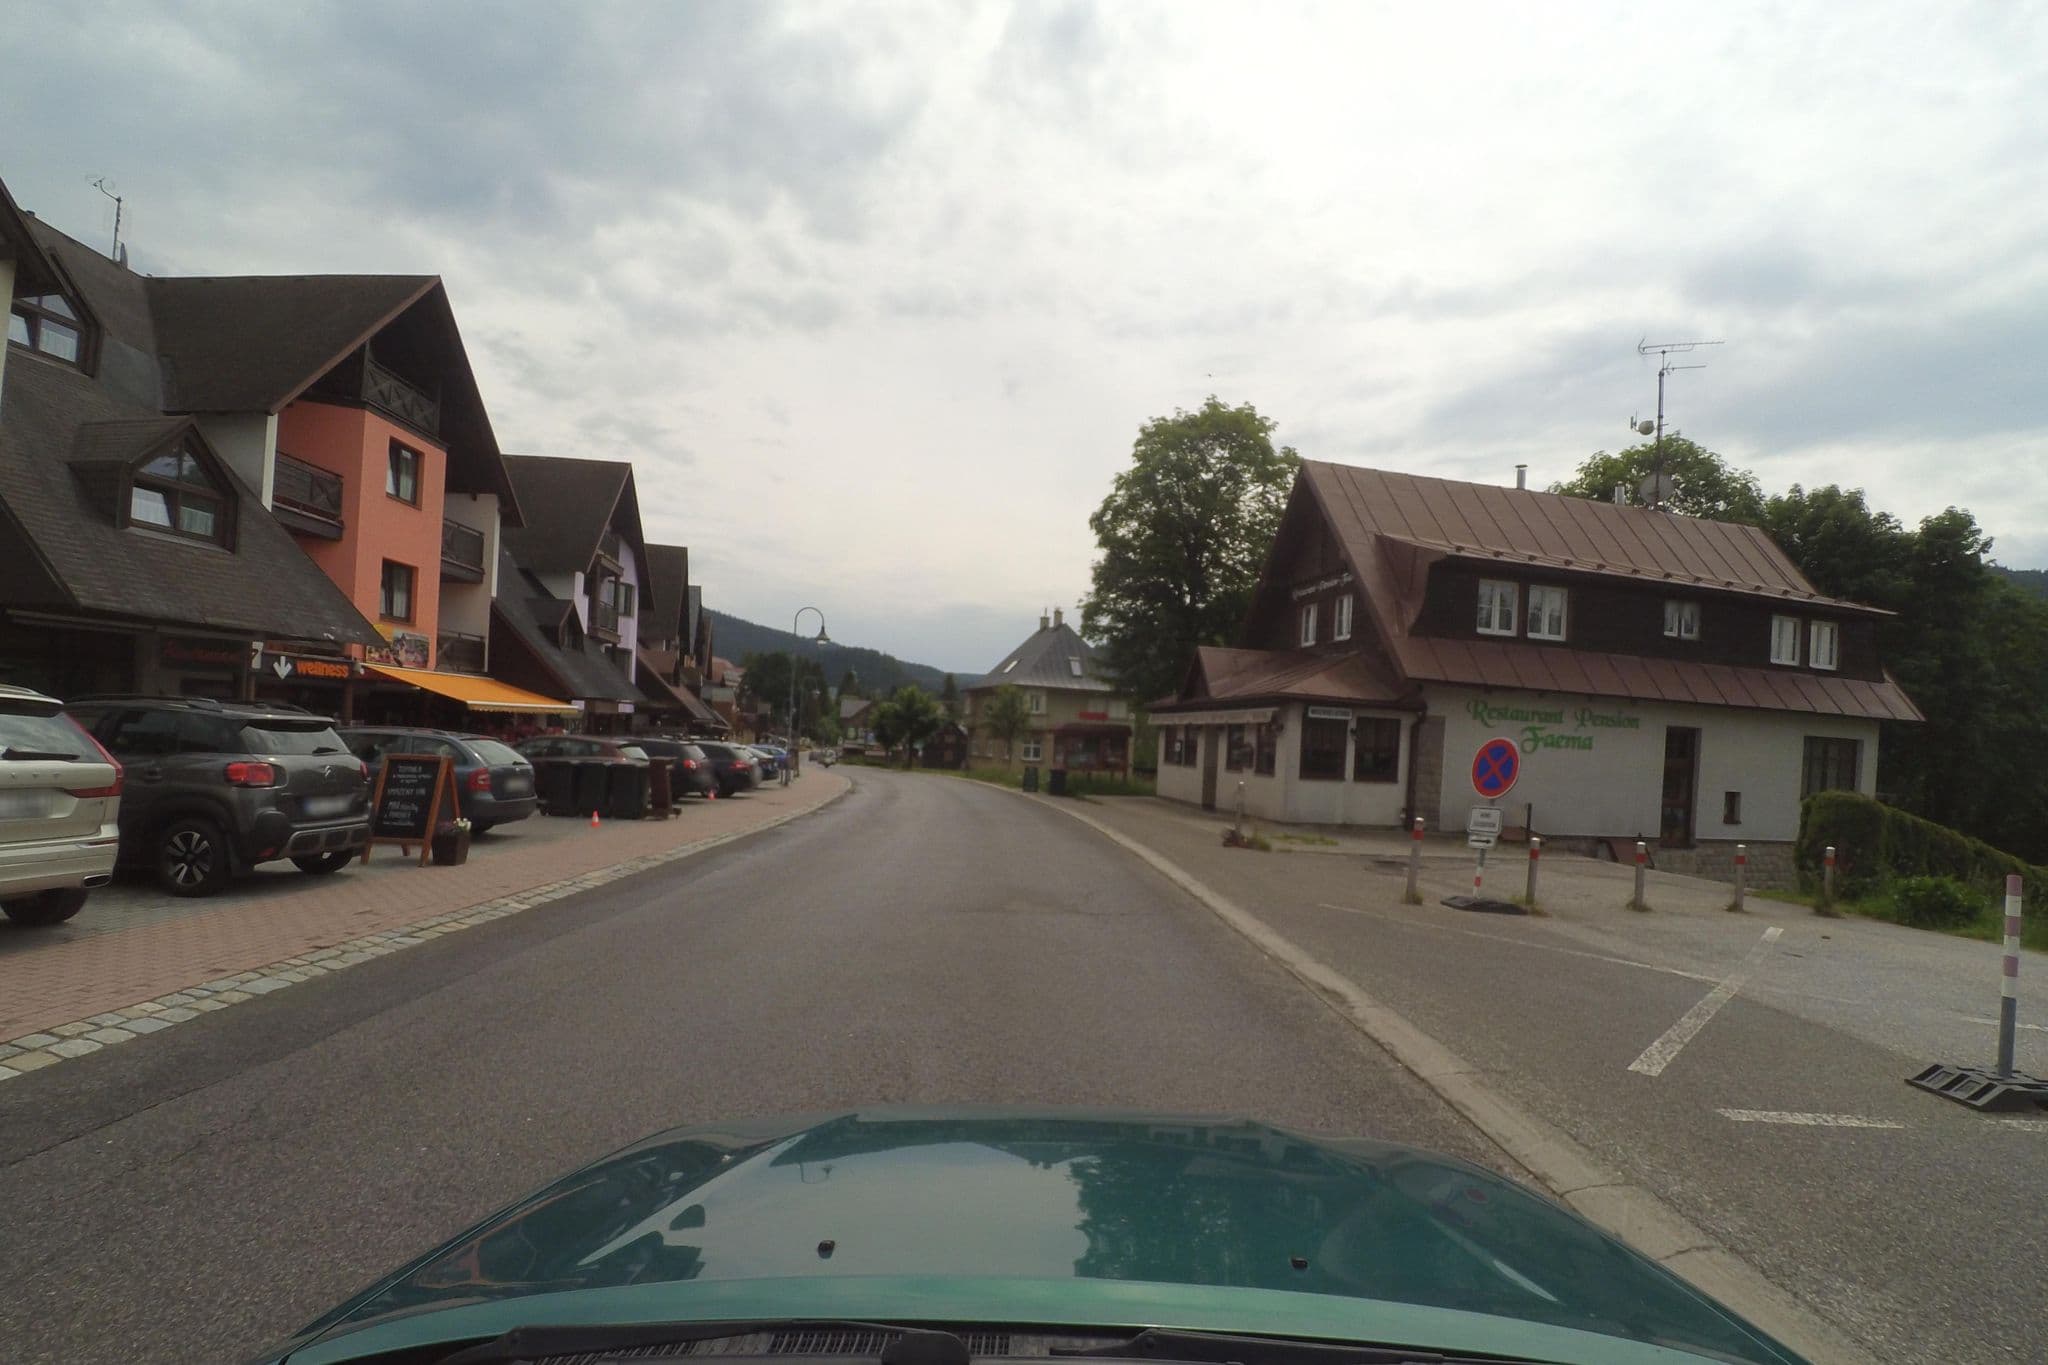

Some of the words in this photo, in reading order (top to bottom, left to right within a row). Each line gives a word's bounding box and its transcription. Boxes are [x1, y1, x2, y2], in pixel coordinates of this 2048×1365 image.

[297, 660, 349, 678] wellness
[1467, 700, 1564, 728] Restaurant
[1575, 707, 1640, 731] Pension
